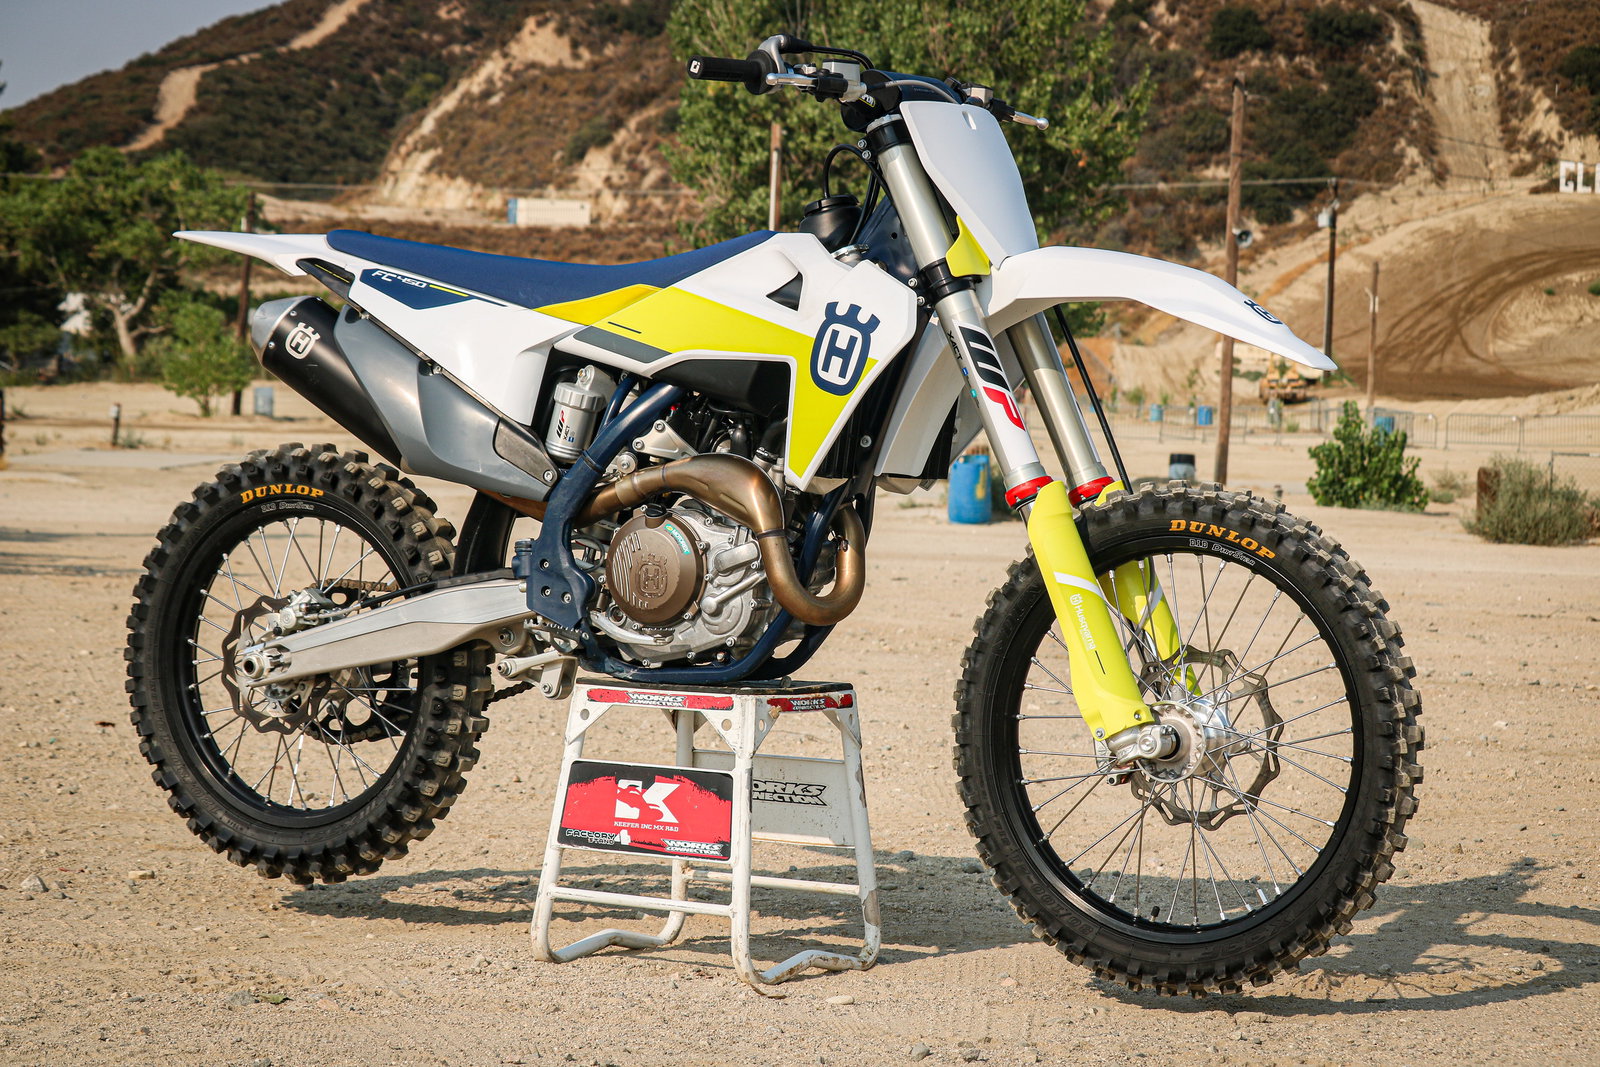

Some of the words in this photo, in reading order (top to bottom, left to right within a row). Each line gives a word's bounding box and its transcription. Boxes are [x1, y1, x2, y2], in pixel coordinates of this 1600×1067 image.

[371, 270, 397, 282] FC
[397, 276, 428, 289] 450
[947, 330, 963, 360] XACT
[240, 484, 324, 503] DUNLOP
[1169, 520, 1276, 559] DUNLOP
[1074, 603, 1096, 648] Husqvarna
[626, 691, 687, 702] WORKS
[790, 698, 826, 706] WORKS
[752, 780, 827, 796] ORKS
[614, 821, 640, 829] KEEFER
[661, 838, 724, 850] WORKS
